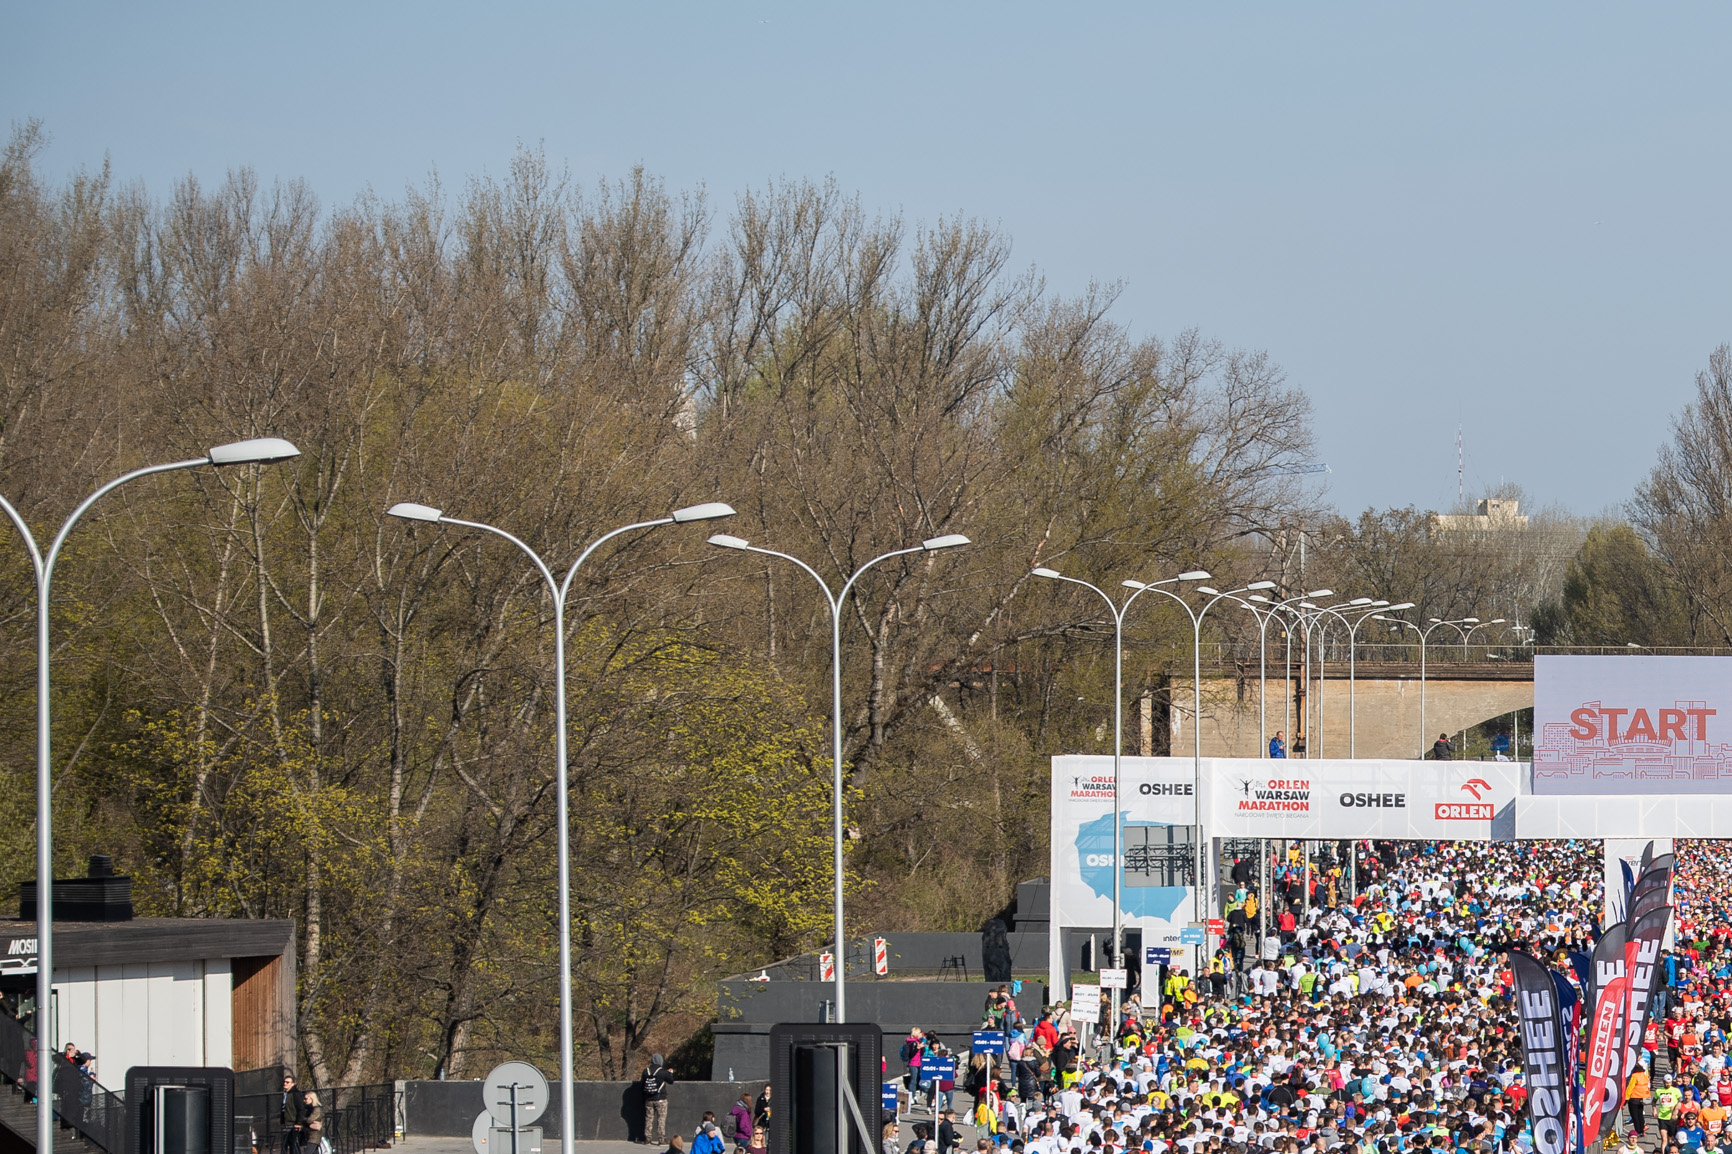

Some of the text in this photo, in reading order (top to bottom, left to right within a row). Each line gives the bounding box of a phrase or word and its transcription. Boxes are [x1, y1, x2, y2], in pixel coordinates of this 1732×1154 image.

[1569, 707, 1717, 741] START
[1139, 783, 1193, 796] OSHEE
[1267, 779, 1310, 790] ORLEN
[1255, 790, 1310, 801] WARSAW
[1340, 793, 1405, 808] OSHEE
[1238, 800, 1310, 811] MARATHON
[1438, 805, 1492, 819] ORLEN
[1594, 1005, 1613, 1073] ORLEN
